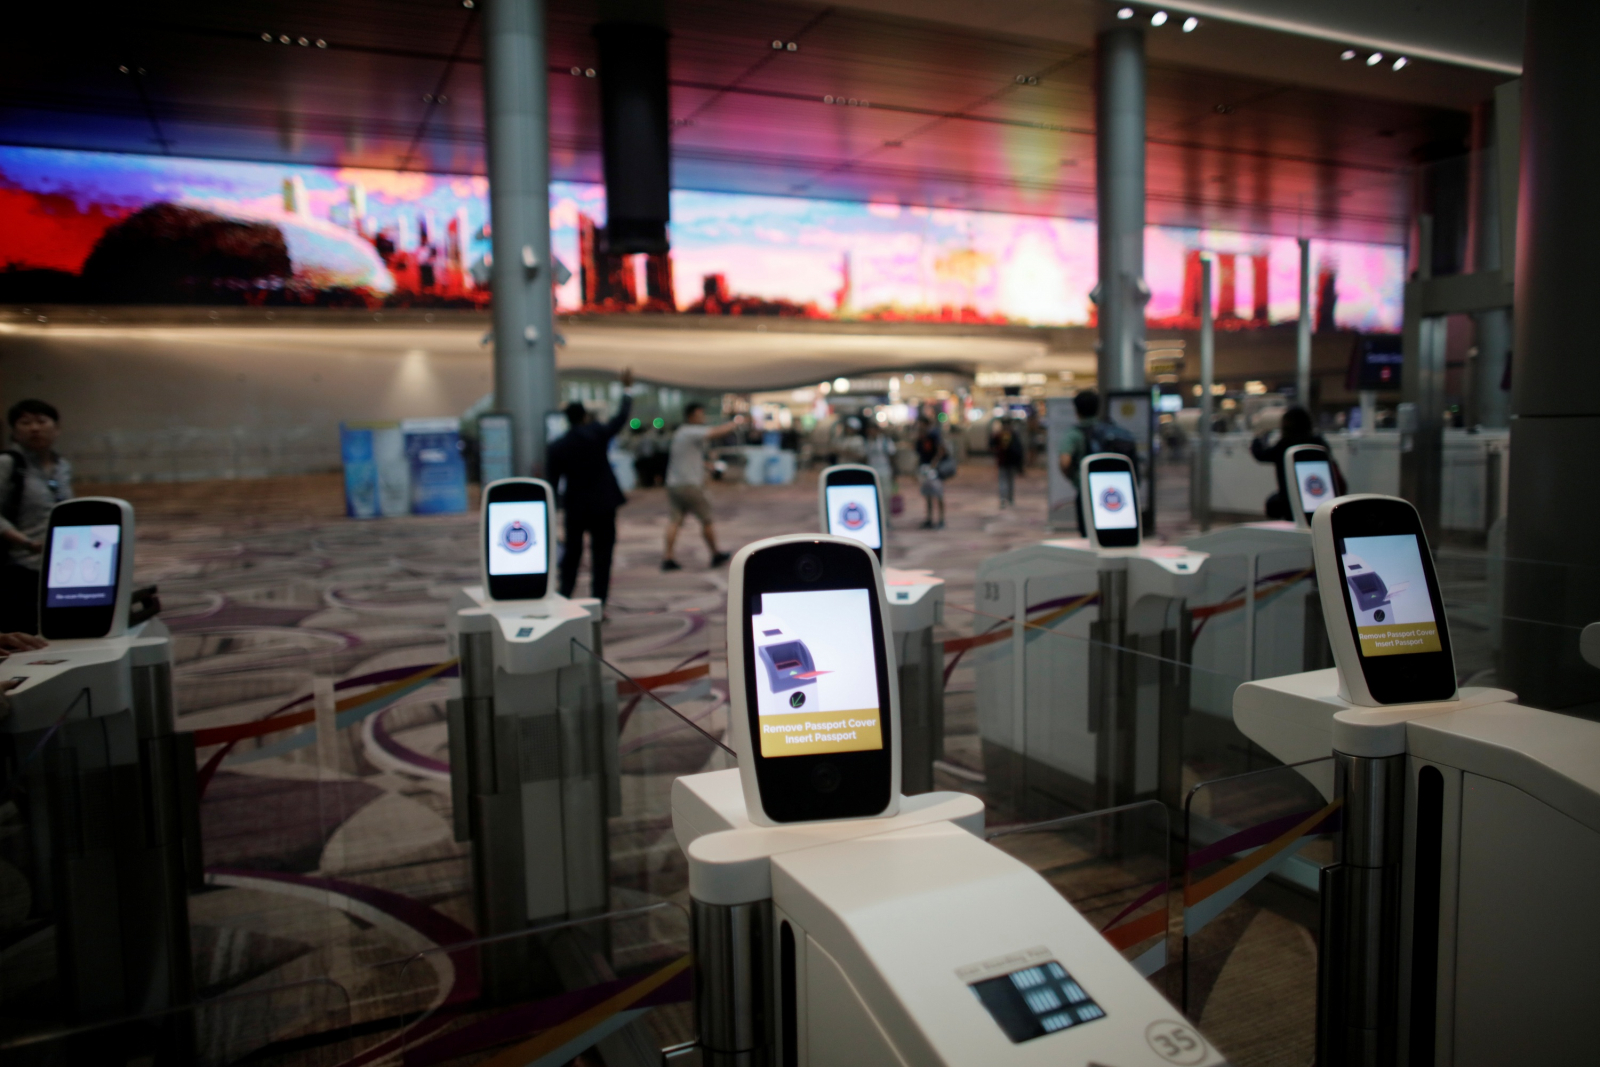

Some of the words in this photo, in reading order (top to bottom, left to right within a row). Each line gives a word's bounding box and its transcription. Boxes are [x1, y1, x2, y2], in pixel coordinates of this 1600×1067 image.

[1387, 630, 1416, 638] Passport
[1395, 638, 1423, 646] Passport
[763, 724, 802, 733] Remove
[804, 720, 847, 732] Passport
[848, 719, 876, 728] Cover
[786, 734, 813, 744] Insert
[815, 731, 857, 742] Passport
[1153, 1027, 1197, 1056] 35
